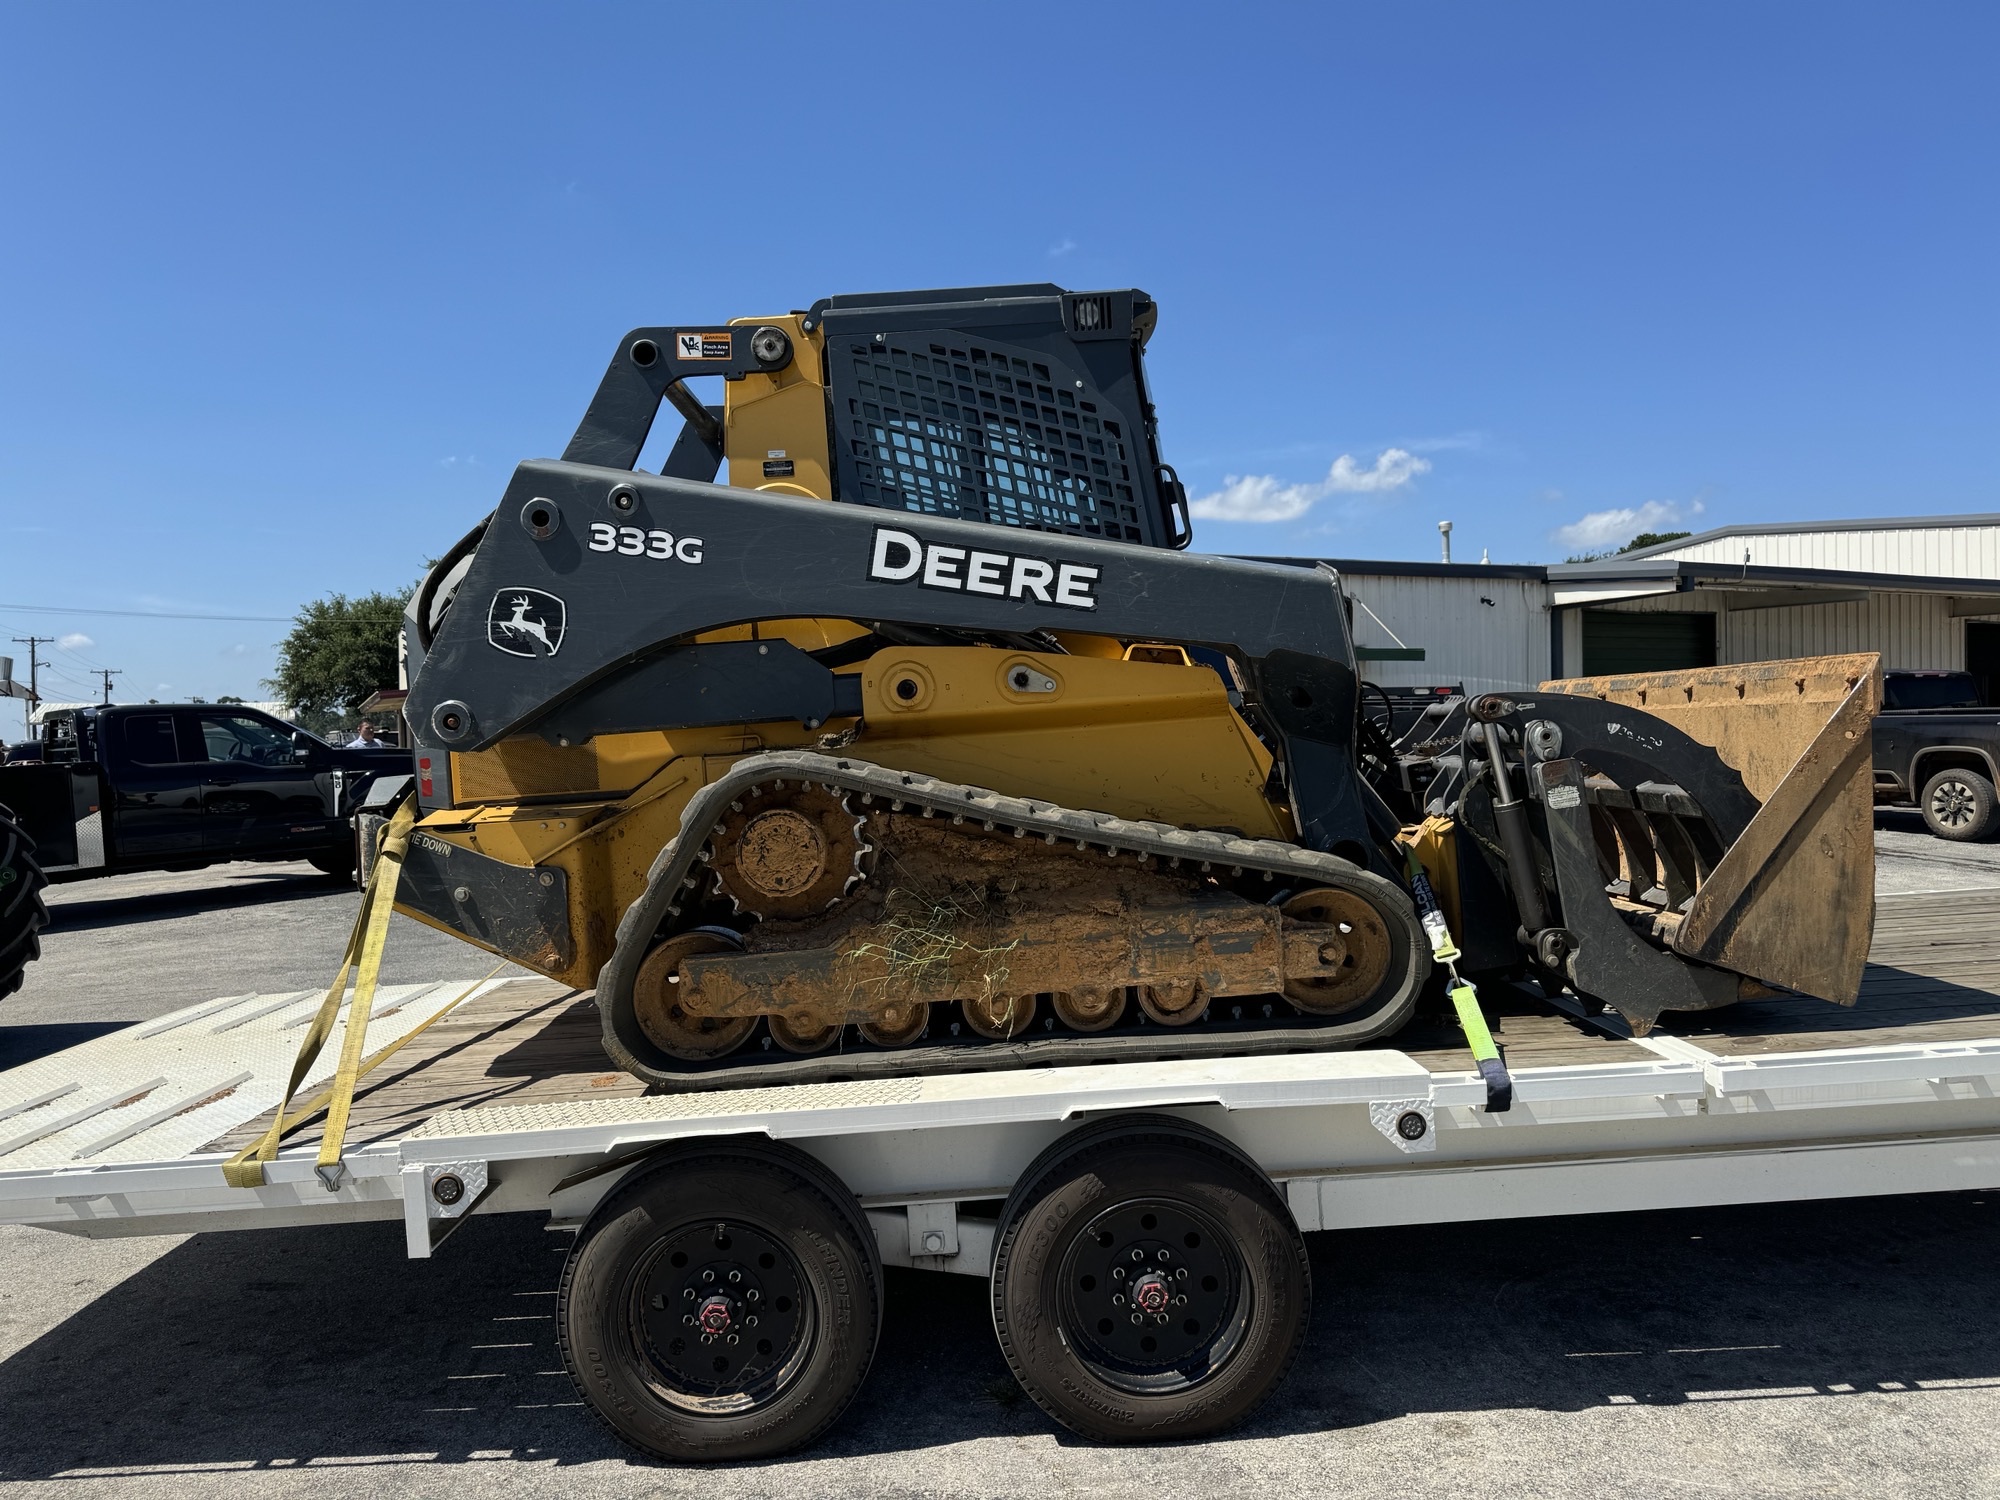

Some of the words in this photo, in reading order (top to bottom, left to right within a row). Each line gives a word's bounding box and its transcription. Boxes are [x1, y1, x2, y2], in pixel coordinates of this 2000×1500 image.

[588, 522, 703, 564] 333G
[871, 528, 1098, 608] DEERE
[422, 837, 451, 855] DOWN
[1410, 875, 1437, 930] VULCAN
[1023, 1200, 1070, 1277] TF300
[587, 1346, 638, 1422] TF300
